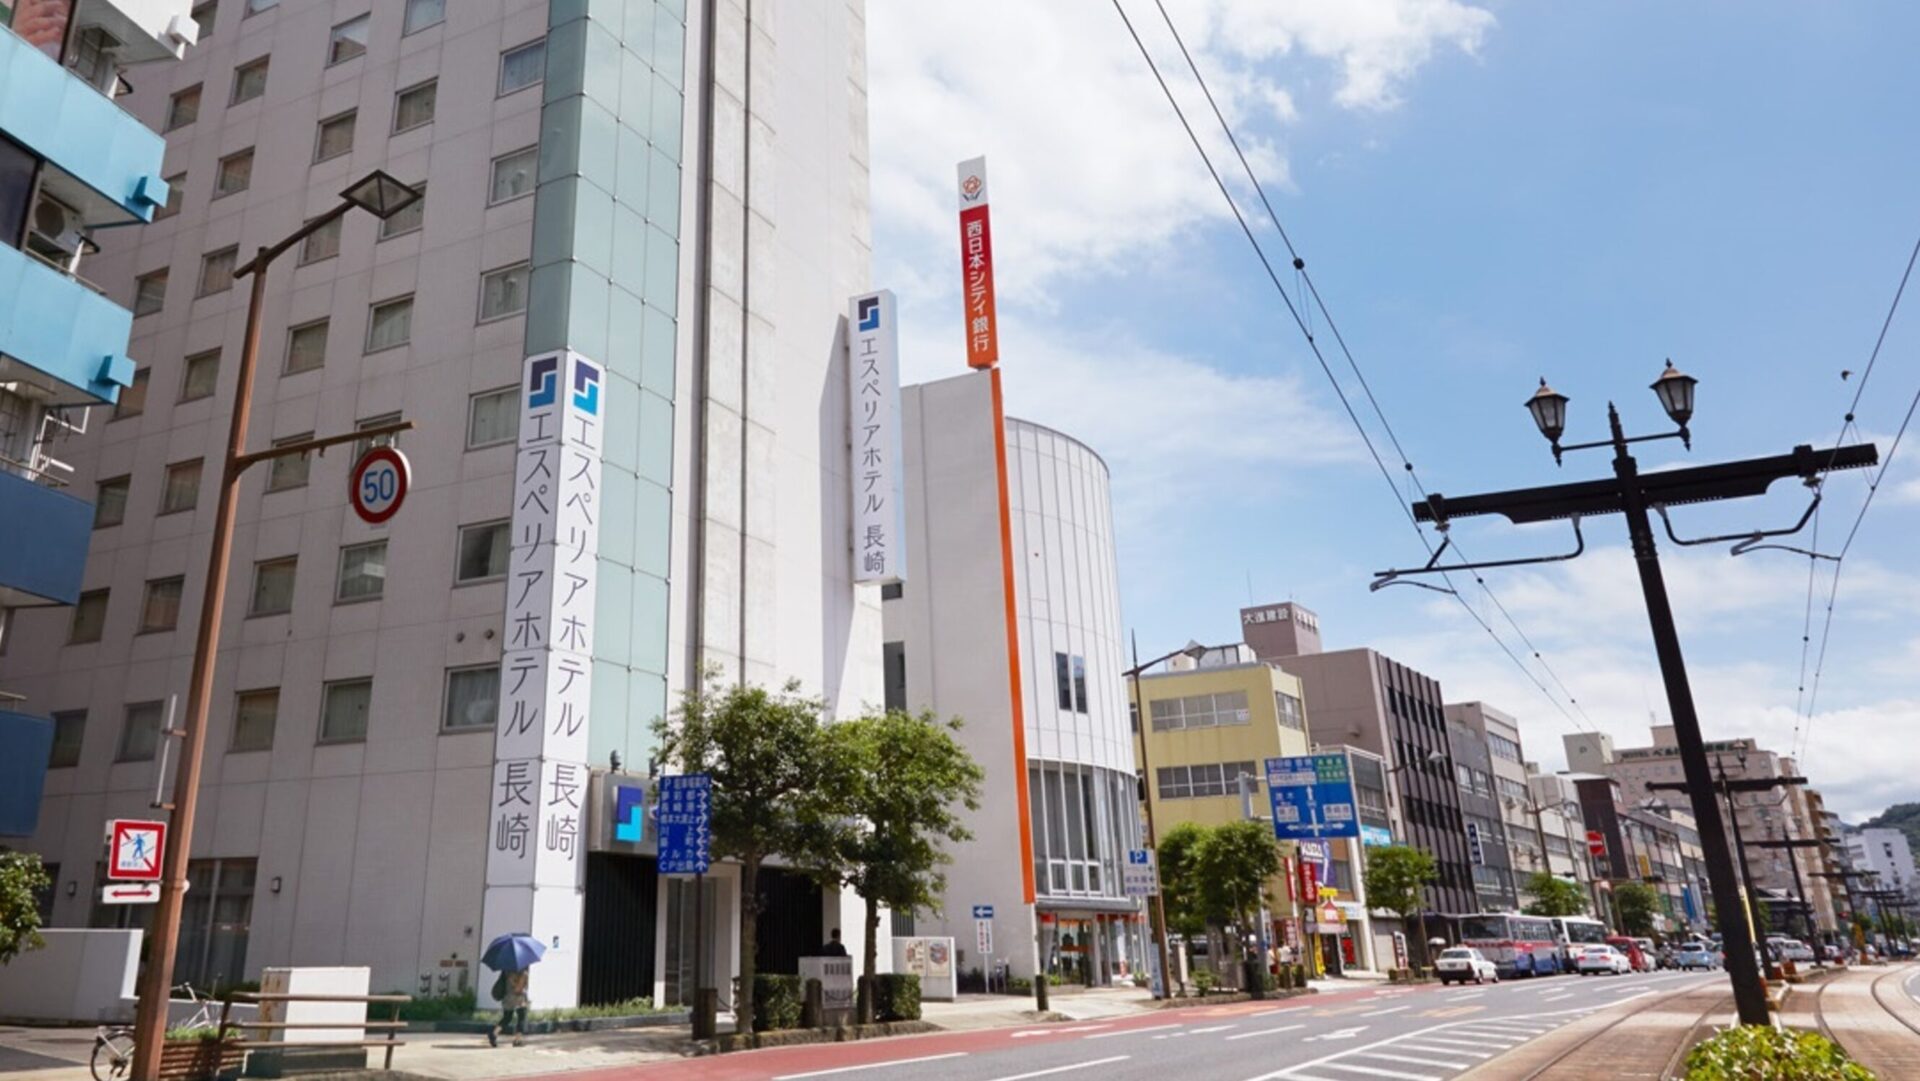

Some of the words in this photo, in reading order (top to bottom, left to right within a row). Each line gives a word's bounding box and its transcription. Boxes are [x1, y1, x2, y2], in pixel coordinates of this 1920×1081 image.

[966, 220, 989, 353] 西日本シティ銀行
[364, 468, 395, 504] 50
[1135, 850, 1143, 863] P
